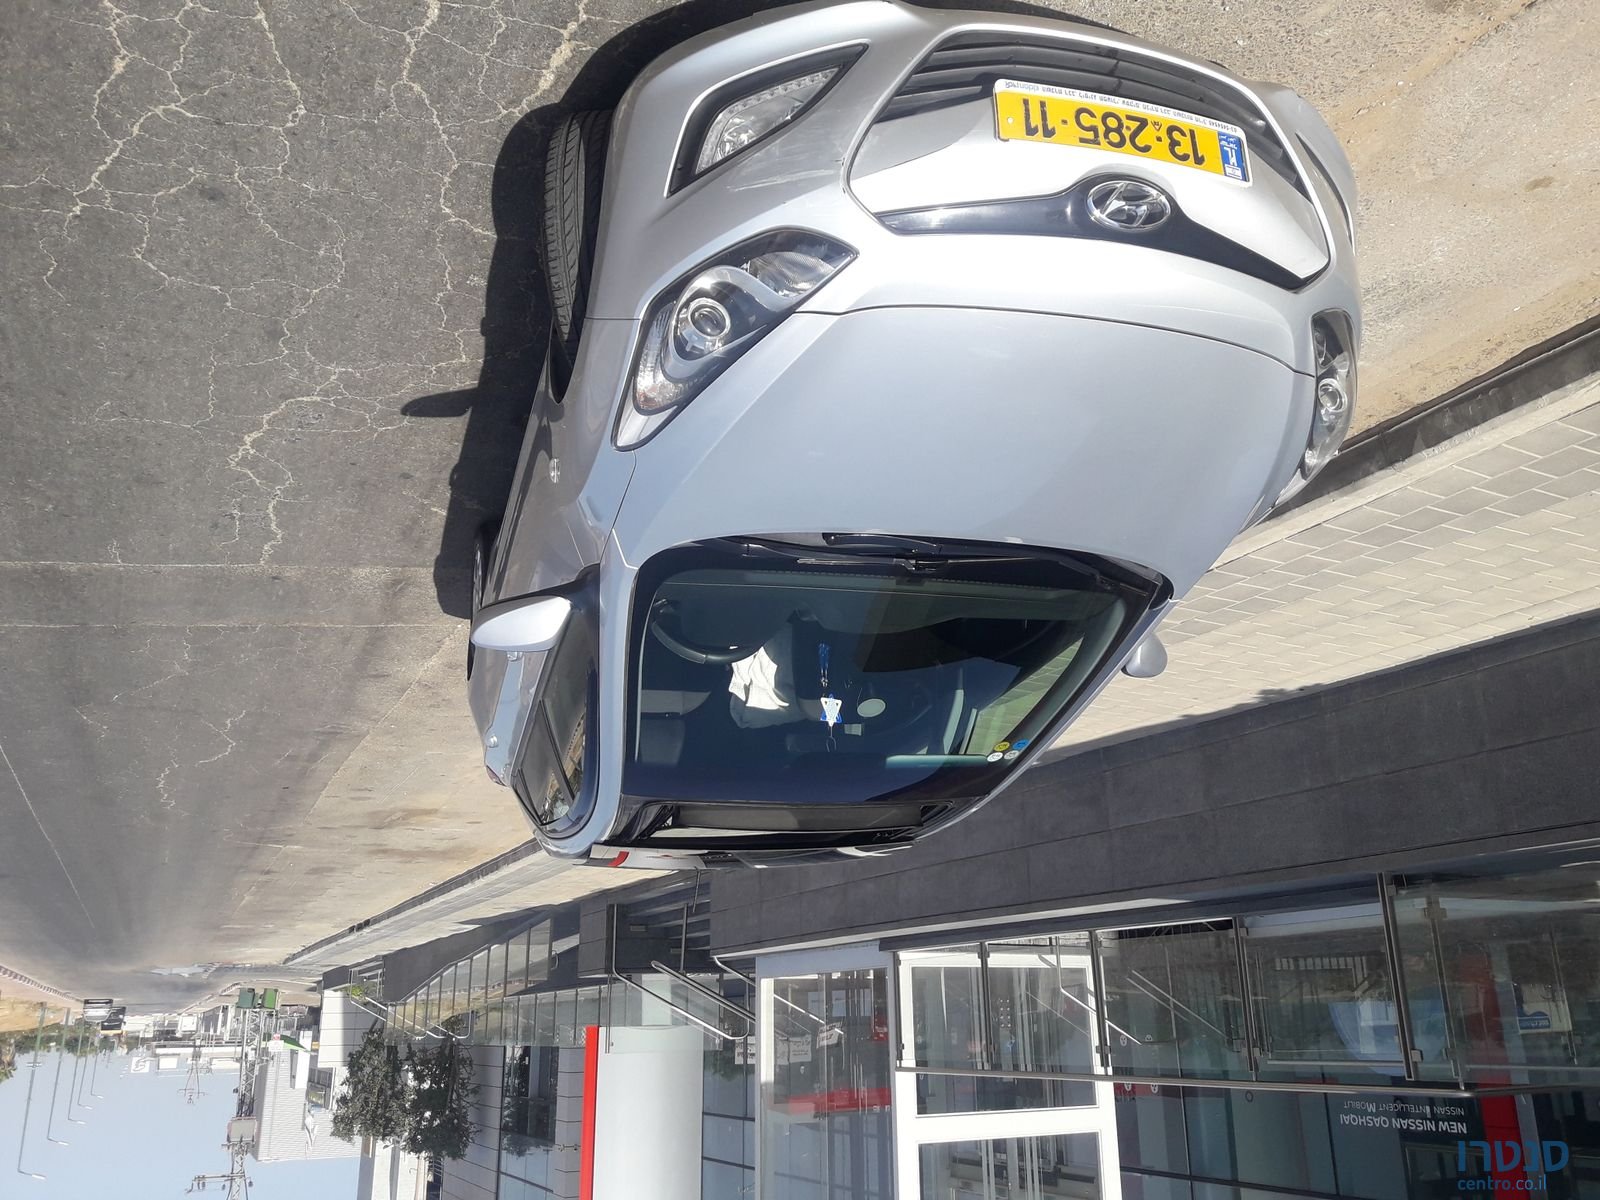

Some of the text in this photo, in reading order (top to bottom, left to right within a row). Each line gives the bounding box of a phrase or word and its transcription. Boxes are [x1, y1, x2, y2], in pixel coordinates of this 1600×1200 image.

[1224, 147, 1238, 167] IL
[1379, 1103, 1431, 1118] INTELLIGENT
[1433, 1106, 1465, 1116] NISSAN
[1340, 1113, 1467, 1134] NEW NISSAN QASHQAI
